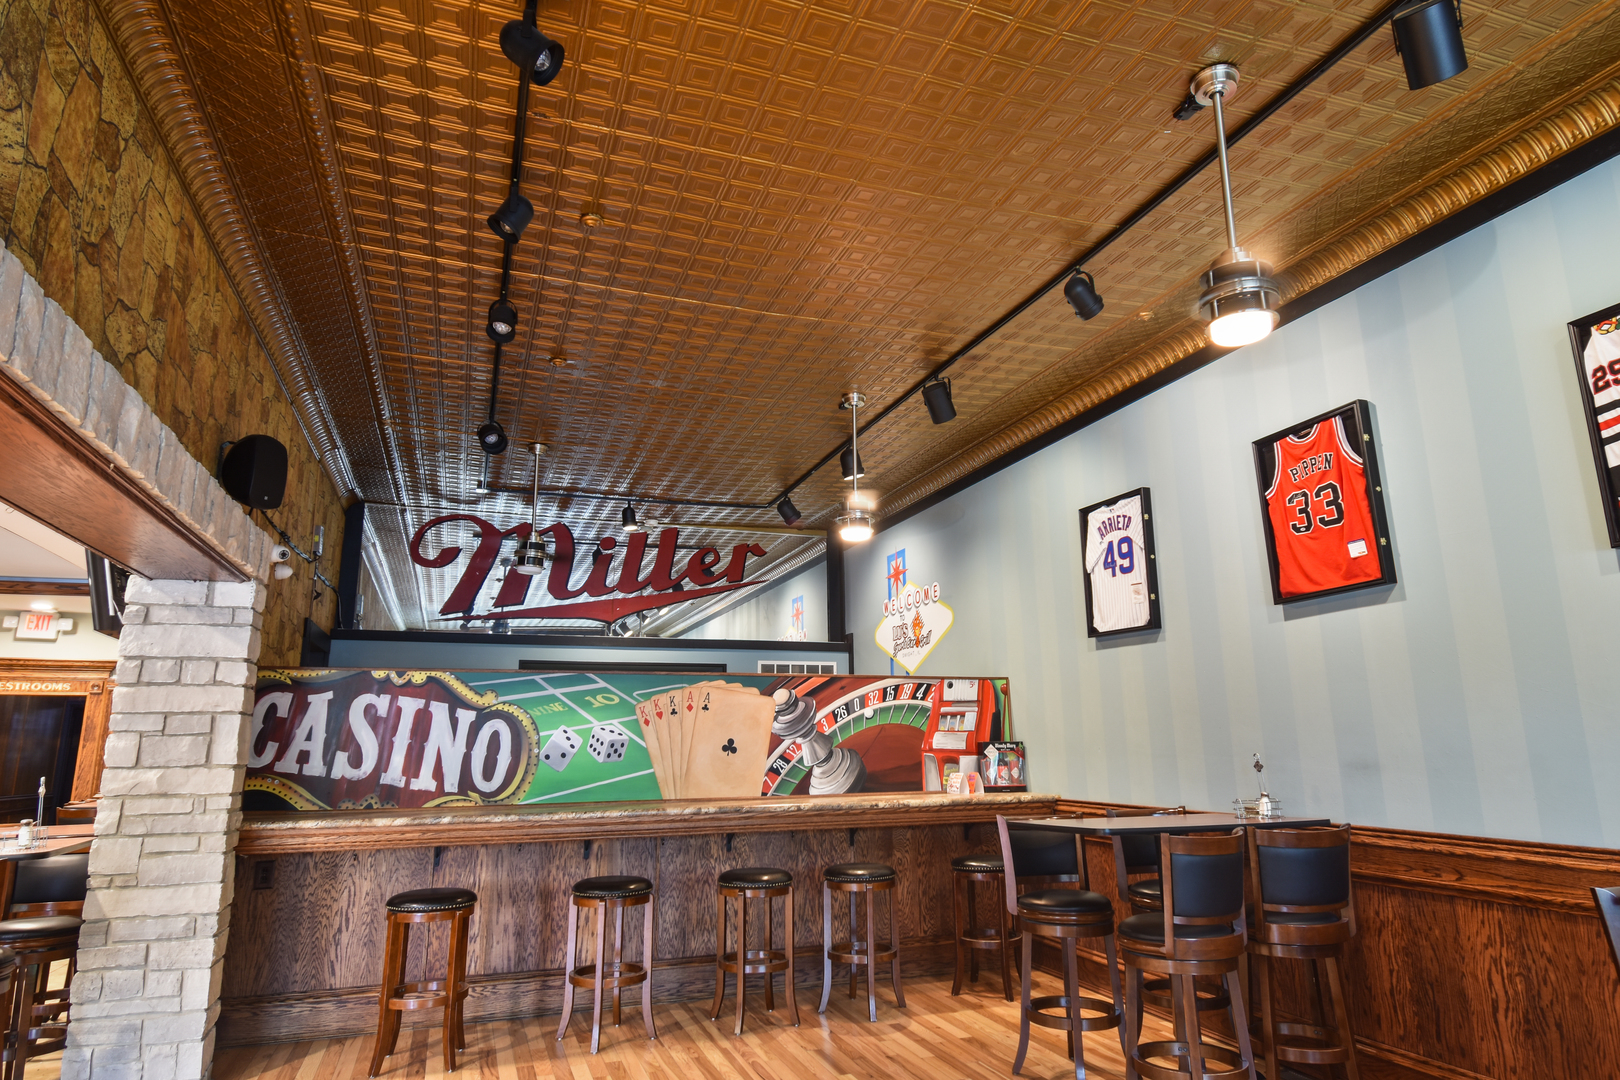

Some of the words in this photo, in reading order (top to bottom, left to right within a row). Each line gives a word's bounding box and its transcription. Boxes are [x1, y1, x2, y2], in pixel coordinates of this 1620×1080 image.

[1288, 452, 1333, 483] PIPPEN
[1286, 481, 1345, 535] 33
[1097, 514, 1132, 540] ARRIETA
[1103, 535, 1135, 578] 49
[410, 514, 767, 616] Miller
[884, 584, 938, 613] WELCOME
[26, 614, 54, 631] EXIT
[686, 691, 694, 702] A
[703, 692, 710, 703] A
[868, 690, 879, 706] 32
[885, 686, 895, 701] 15
[900, 683, 913, 699] 19
[916, 684, 927, 700] 4
[584, 693, 620, 708] 10
[653, 699, 661, 711] K
[669, 696, 676, 707] K
[854, 698, 860, 711] 0
[528, 702, 568, 717] NINE
[639, 705, 648, 718] K
[835, 706, 848, 721] 26
[821, 718, 828, 731] 3
[247, 690, 513, 793] CASINO
[786, 744, 802, 758] 12
[773, 758, 788, 773] 28
